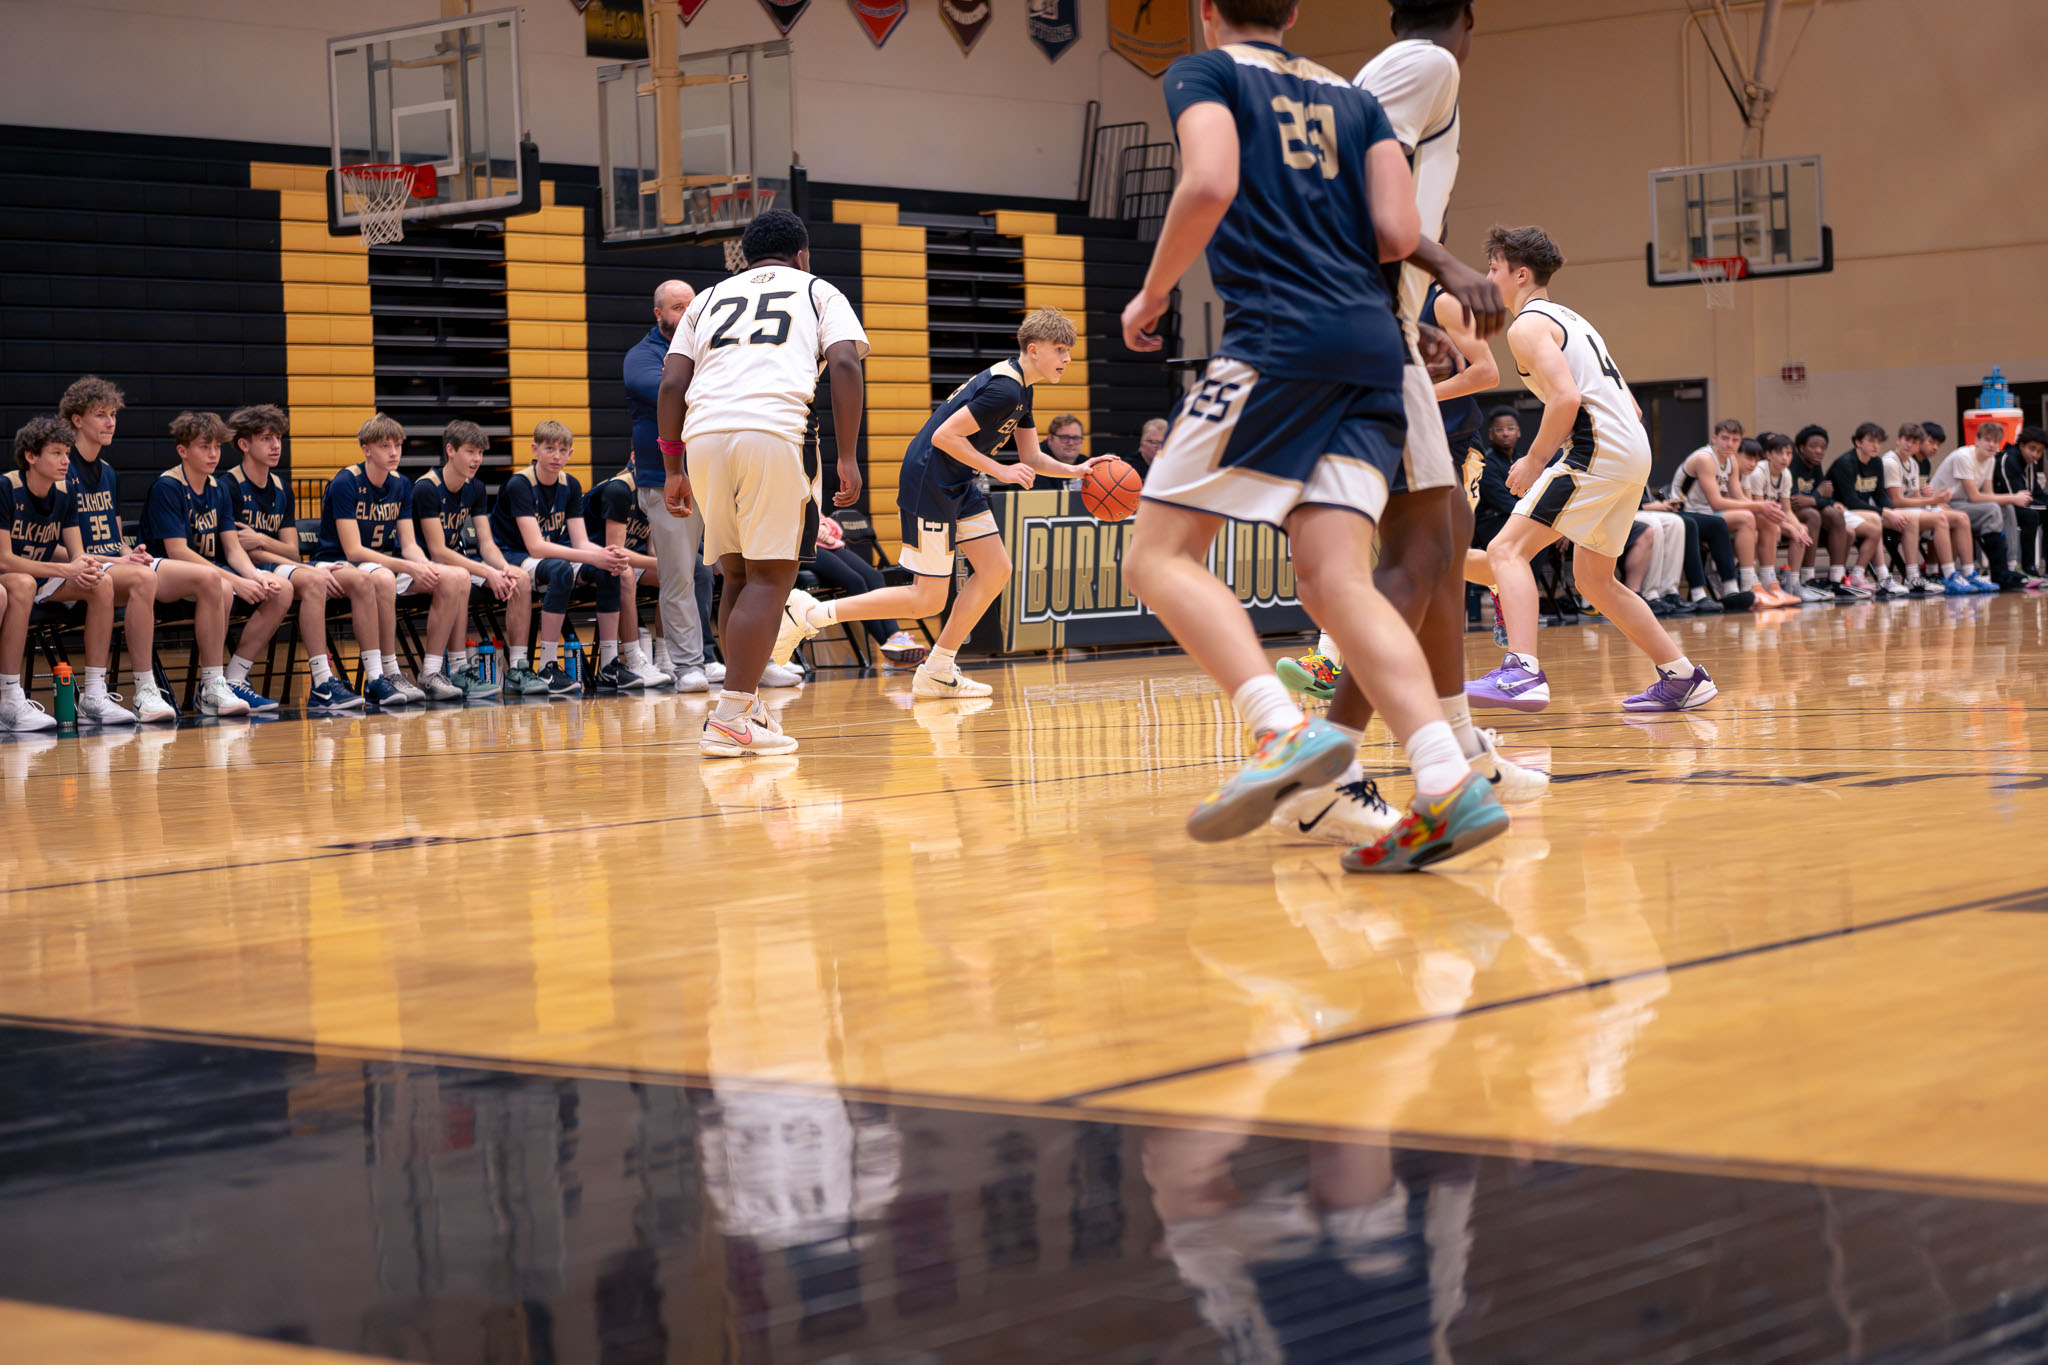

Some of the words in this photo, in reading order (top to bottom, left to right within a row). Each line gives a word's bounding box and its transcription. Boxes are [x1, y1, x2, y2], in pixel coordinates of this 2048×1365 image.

[709, 291, 797, 350] 25
[1586, 334, 1623, 390] 4
[1188, 379, 1241, 422] ES
[77, 490, 114, 512] ELKHOR
[355, 501, 402, 521] ELKHORN
[11, 520, 61, 543] ELKHON
[90, 514, 111, 541] 35
[370, 524, 385, 548] 5
